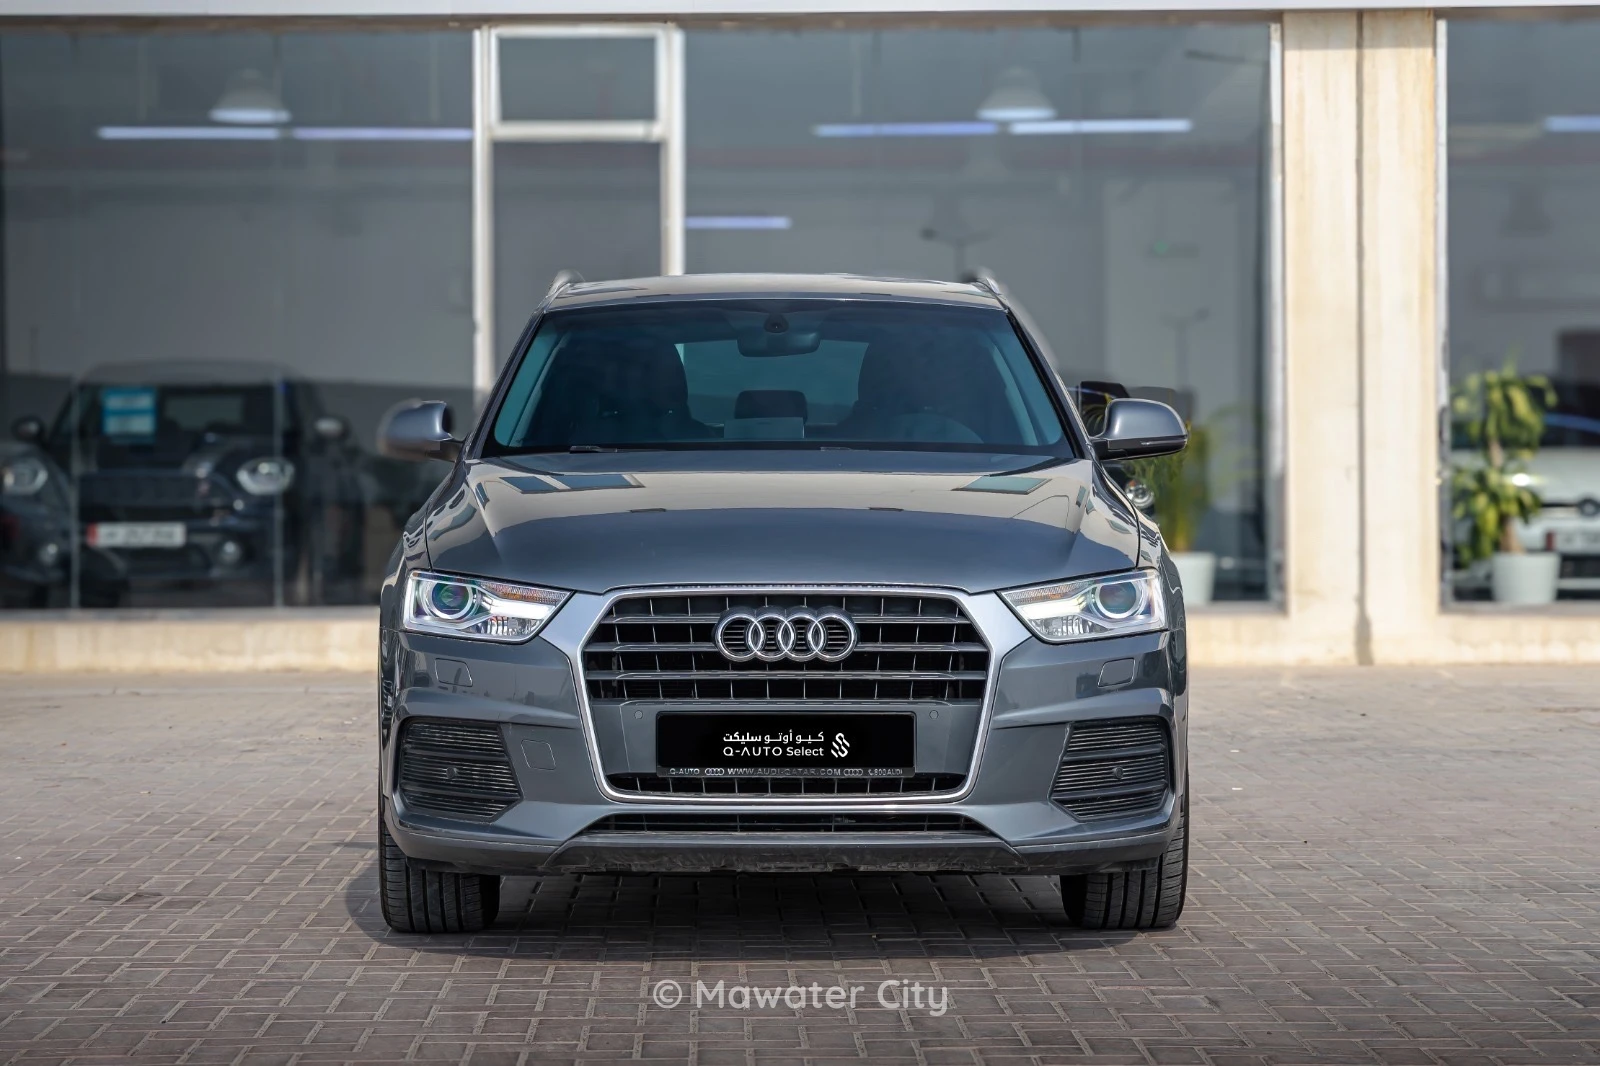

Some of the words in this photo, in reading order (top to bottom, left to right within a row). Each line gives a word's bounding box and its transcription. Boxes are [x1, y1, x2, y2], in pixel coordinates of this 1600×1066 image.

[723, 731, 762, 744] سليكت
[764, 729, 793, 744] أوتو
[723, 746, 783, 757] Q-AUTO
[786, 746, 824, 757] Select
